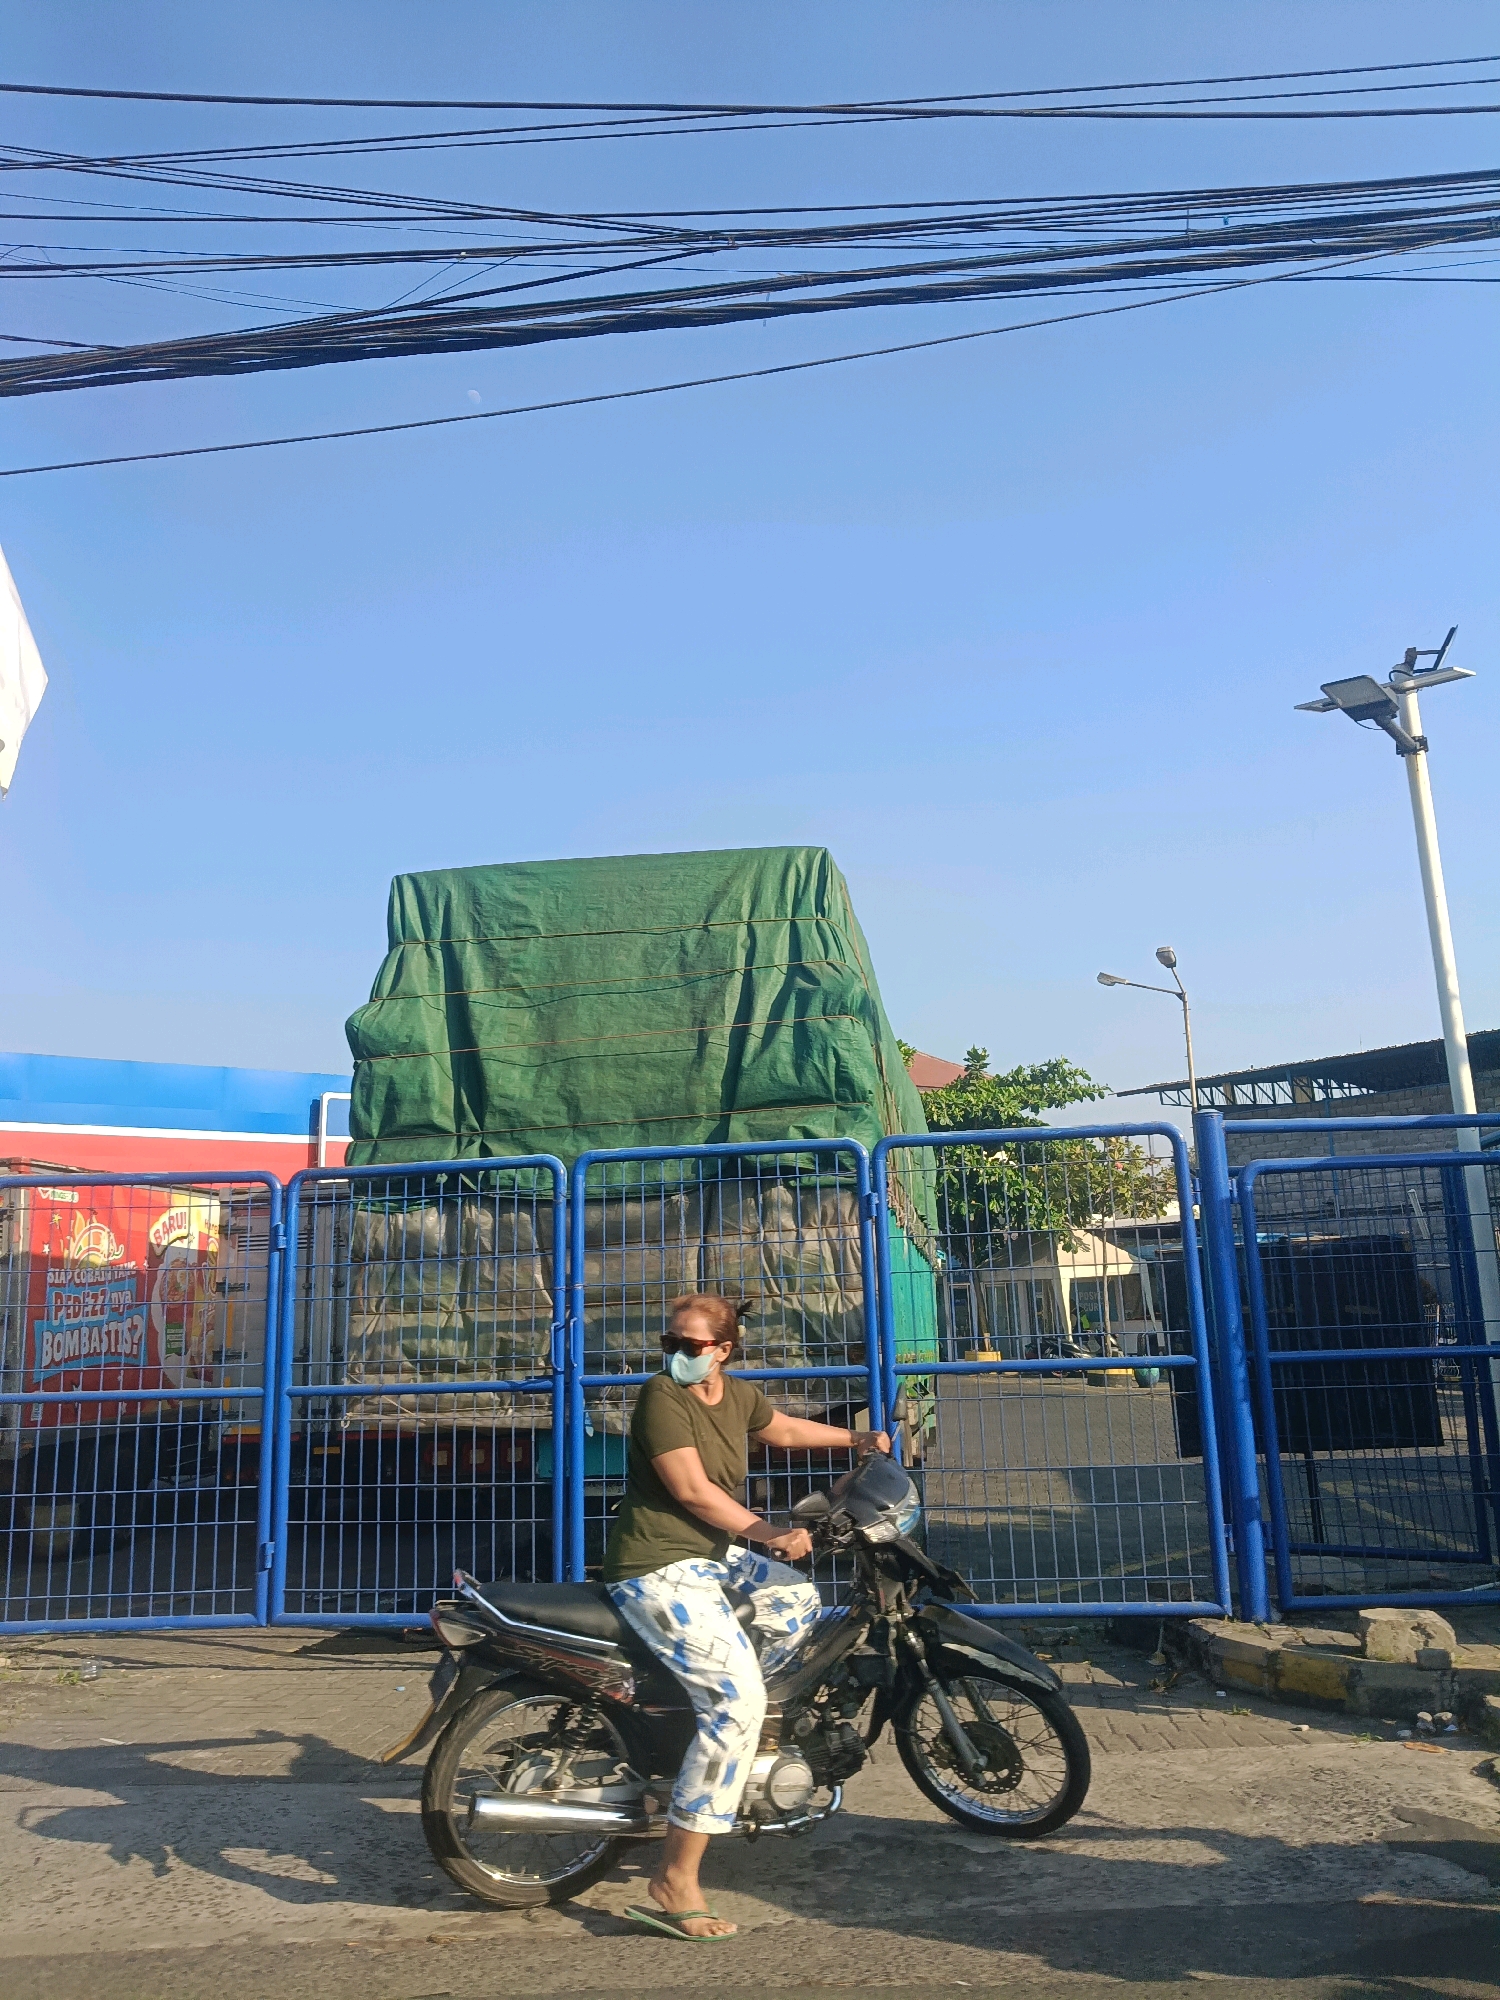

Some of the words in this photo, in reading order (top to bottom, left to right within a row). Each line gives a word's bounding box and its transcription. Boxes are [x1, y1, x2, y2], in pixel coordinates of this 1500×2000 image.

[153, 1211, 187, 1246] BARU!
[47, 1268, 72, 1284] SIAP
[42, 1314, 144, 1367] BOMBASTIS?
